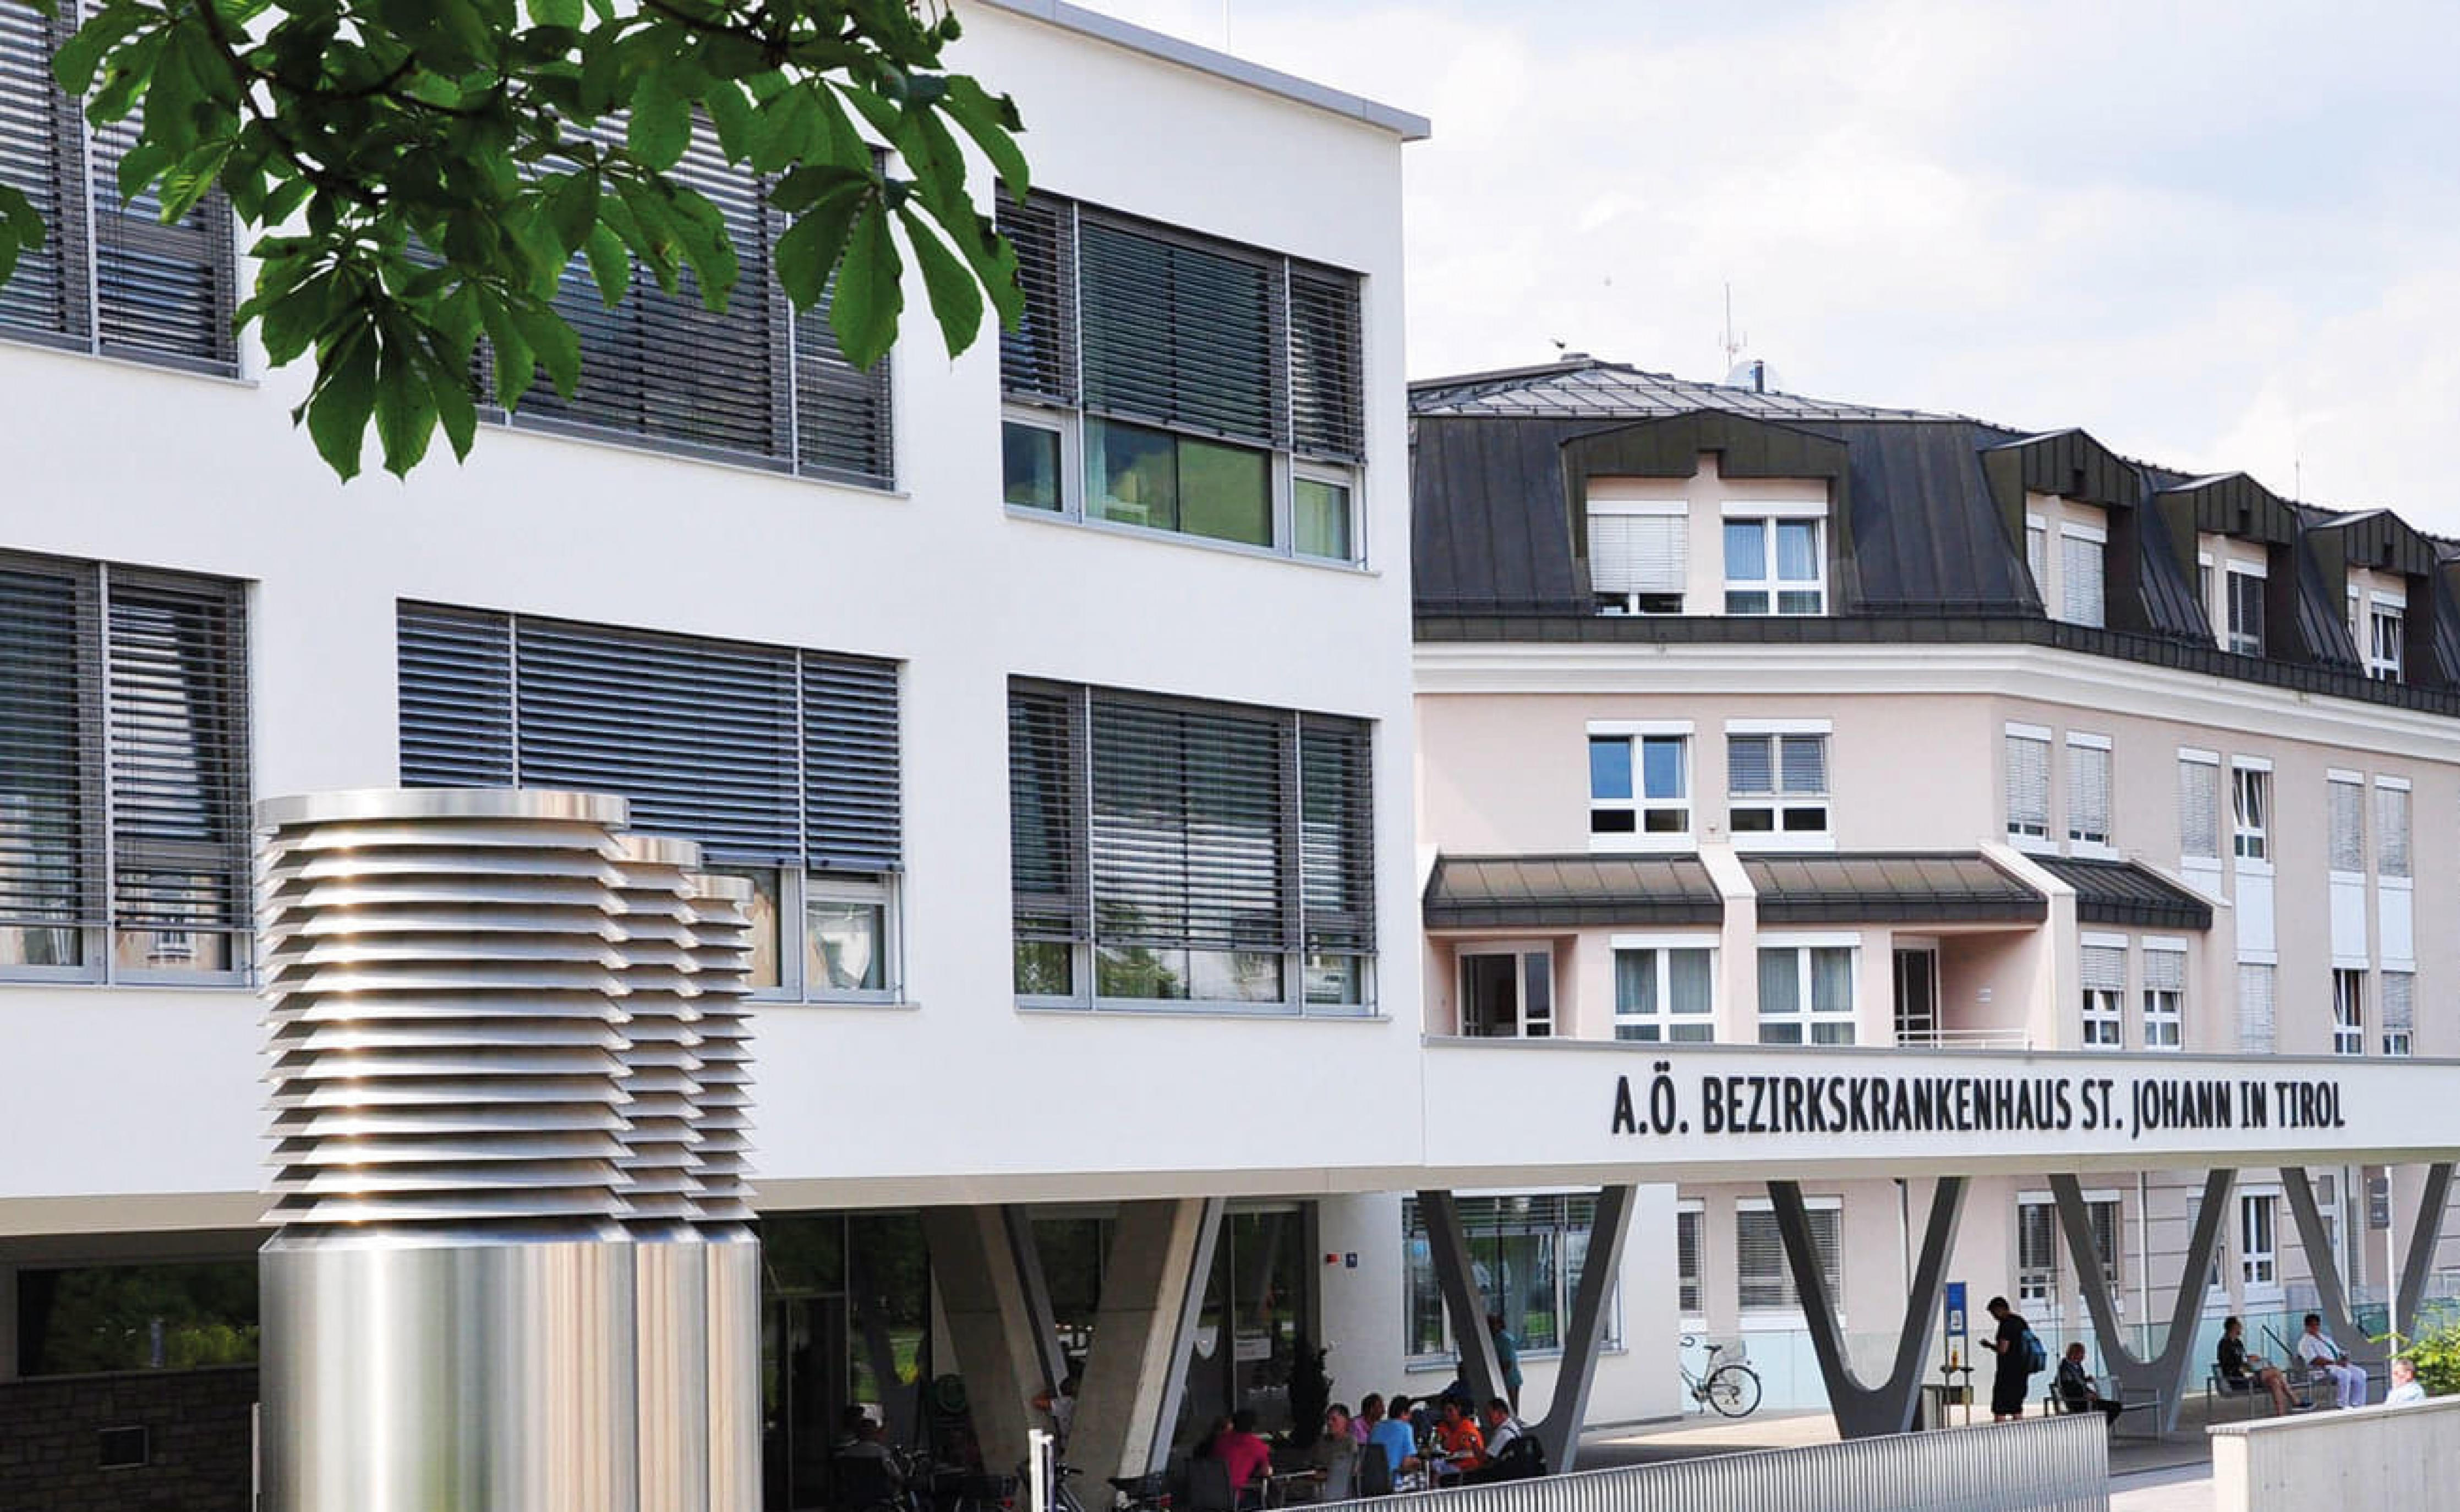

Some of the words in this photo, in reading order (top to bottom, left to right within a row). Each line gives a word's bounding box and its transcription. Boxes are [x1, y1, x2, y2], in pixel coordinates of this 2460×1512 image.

[1612, 1061, 1689, 1135] A.Ö.
[1702, 1076, 2072, 1134] BEZIRKSKRANKENHAUS
[2081, 1078, 2123, 1130] ST.
[2131, 1078, 2232, 1140] JOHANN
[2240, 1081, 2267, 1128] IN
[2274, 1081, 2346, 1128] TIROL
